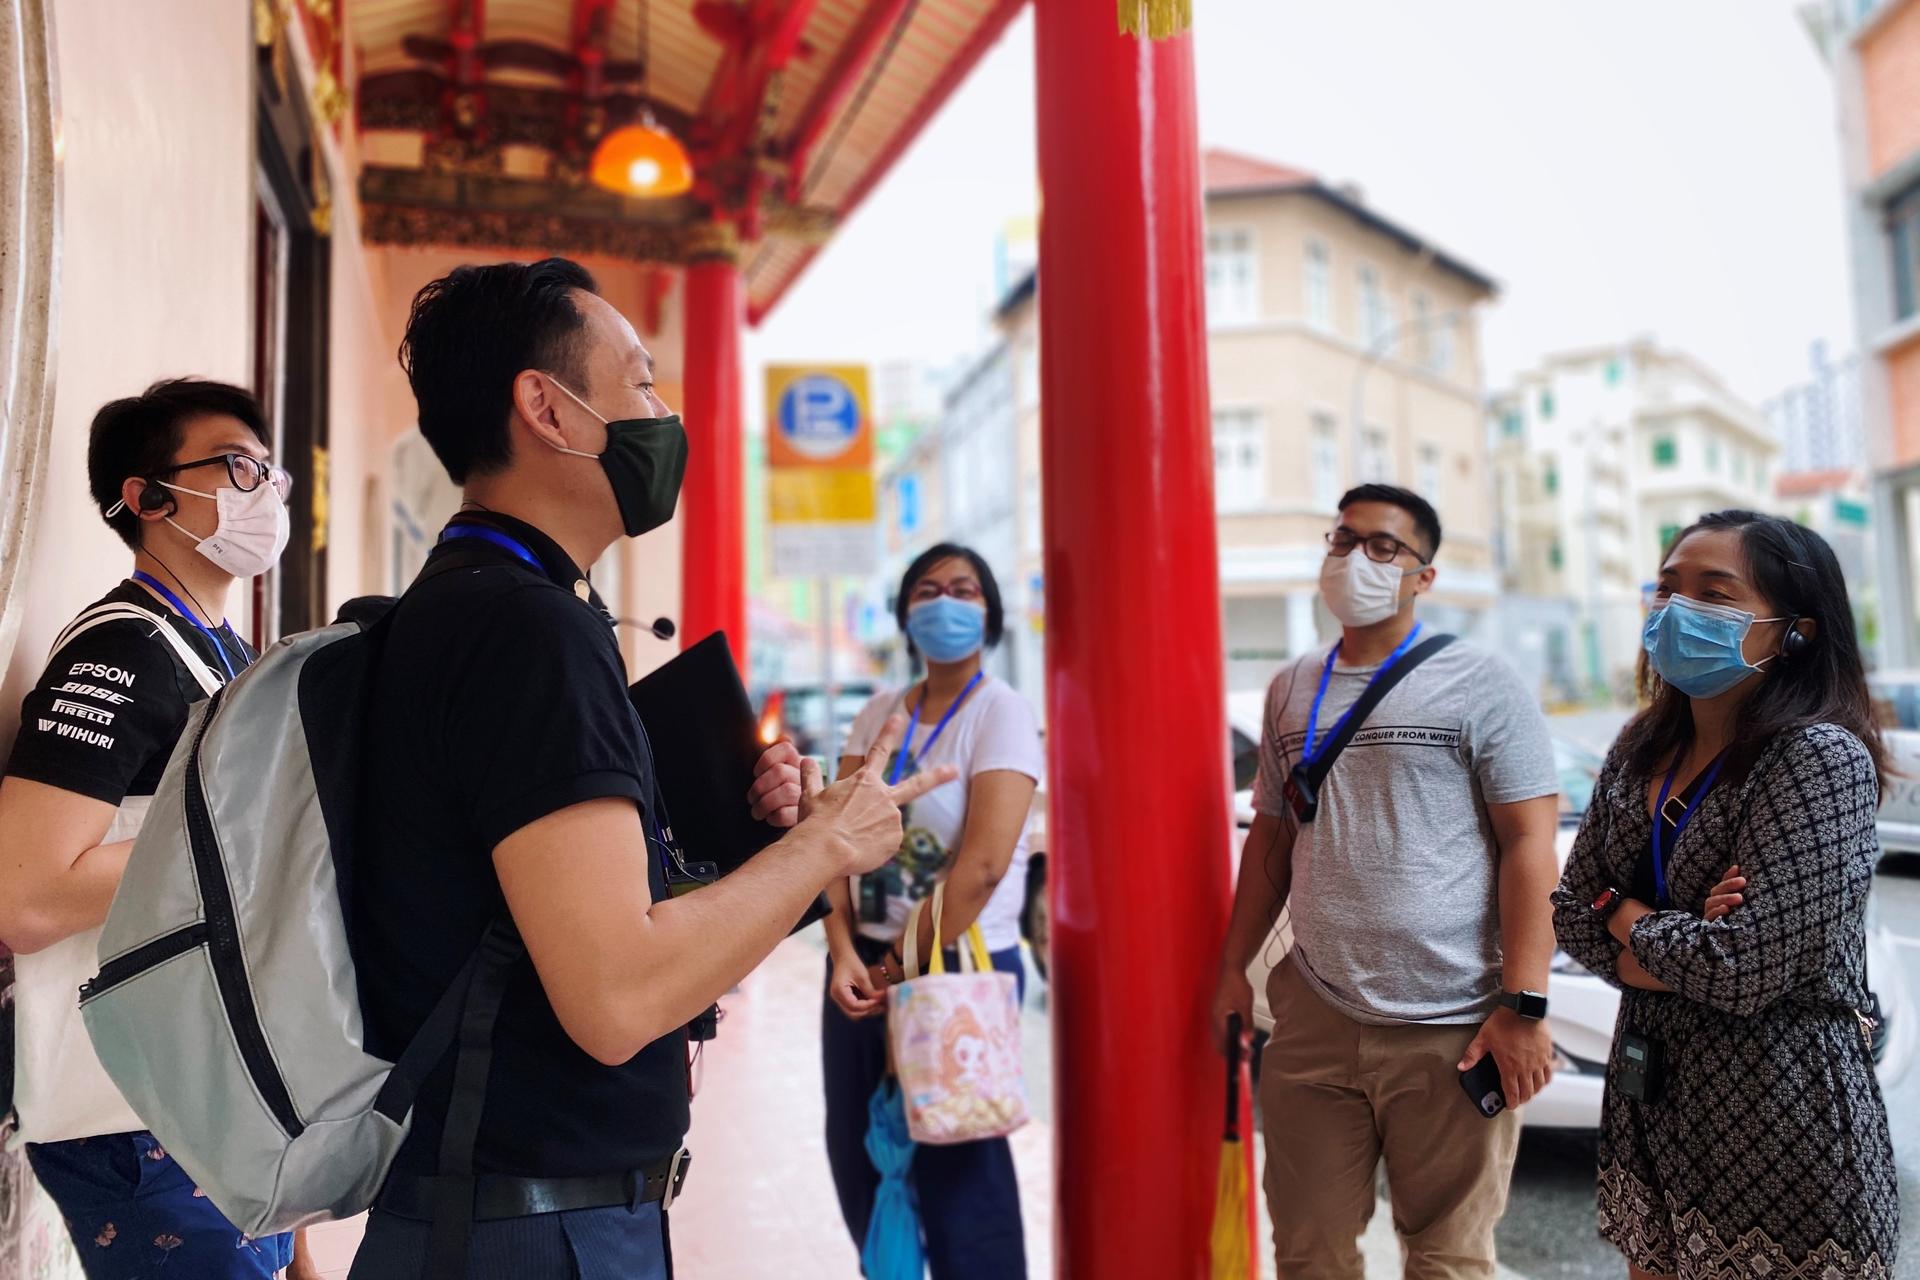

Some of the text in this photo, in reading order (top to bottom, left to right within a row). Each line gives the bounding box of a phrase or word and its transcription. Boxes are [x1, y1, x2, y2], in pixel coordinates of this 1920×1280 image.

[68, 663, 136, 688] EPSON
[50, 682, 135, 705] BOSE
[51, 699, 115, 726] PIRELLI
[57, 722, 114, 750] WIHURI
[1354, 732, 1394, 742] CONQUER
[1396, 731, 1426, 740] FROM
